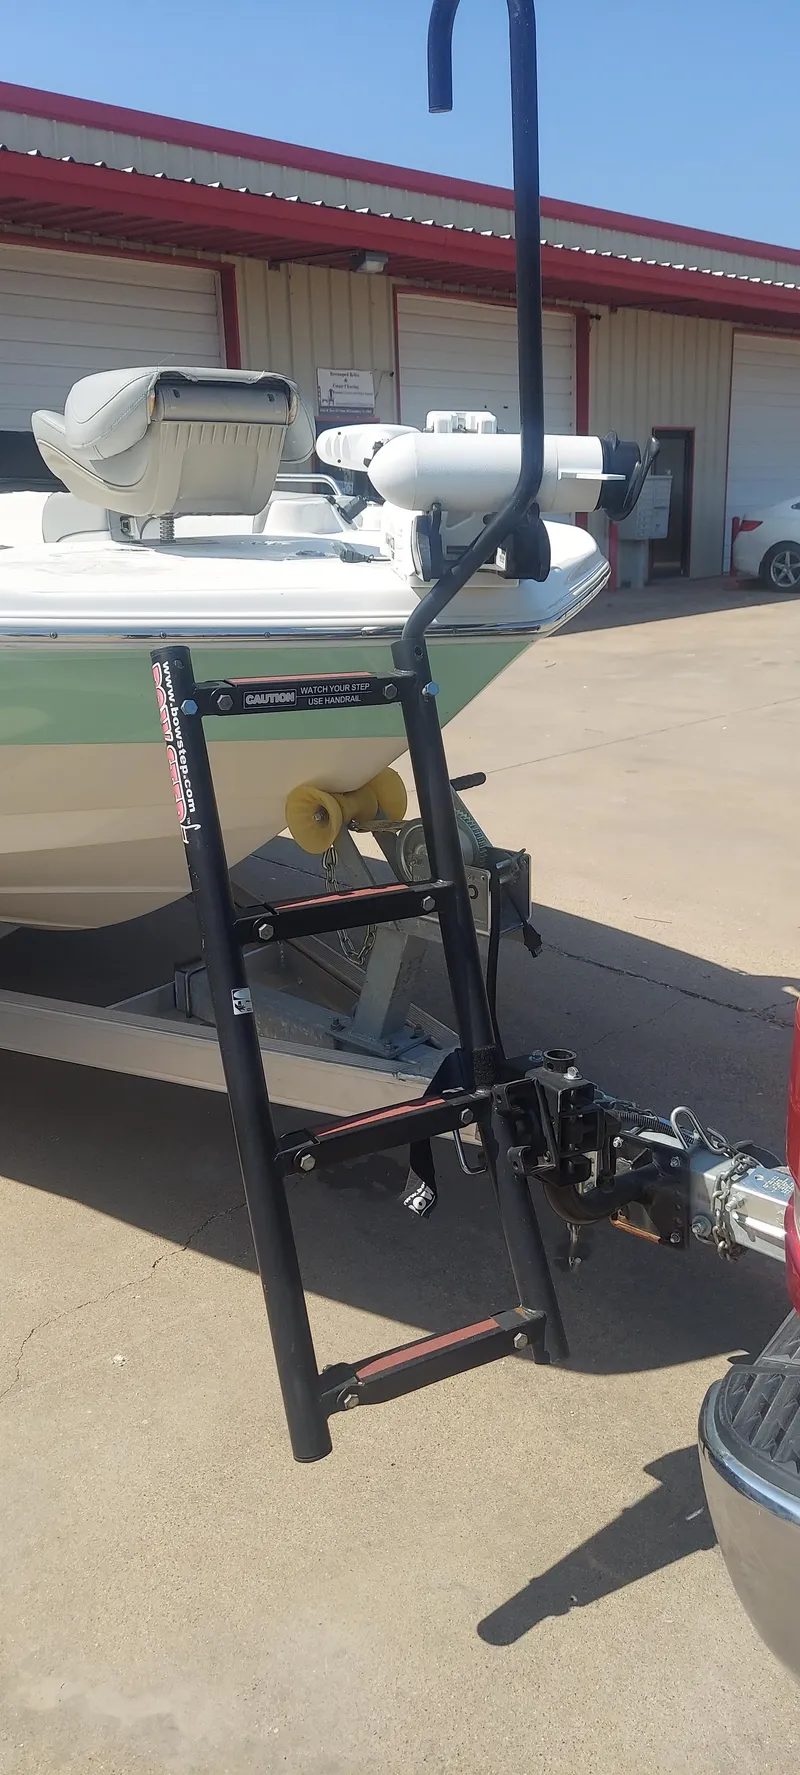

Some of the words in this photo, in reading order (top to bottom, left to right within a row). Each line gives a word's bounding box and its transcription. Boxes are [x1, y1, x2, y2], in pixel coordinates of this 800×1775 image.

[300, 685, 328, 694] WATCH
[329, 684, 350, 693] YOUR
[351, 682, 370, 691] STEP
[245, 691, 295, 705] CAUTION
[308, 697, 324, 705] USE
[325, 695, 361, 705] HANDRAIL
[162, 660, 196, 813] www.bowstep.com
